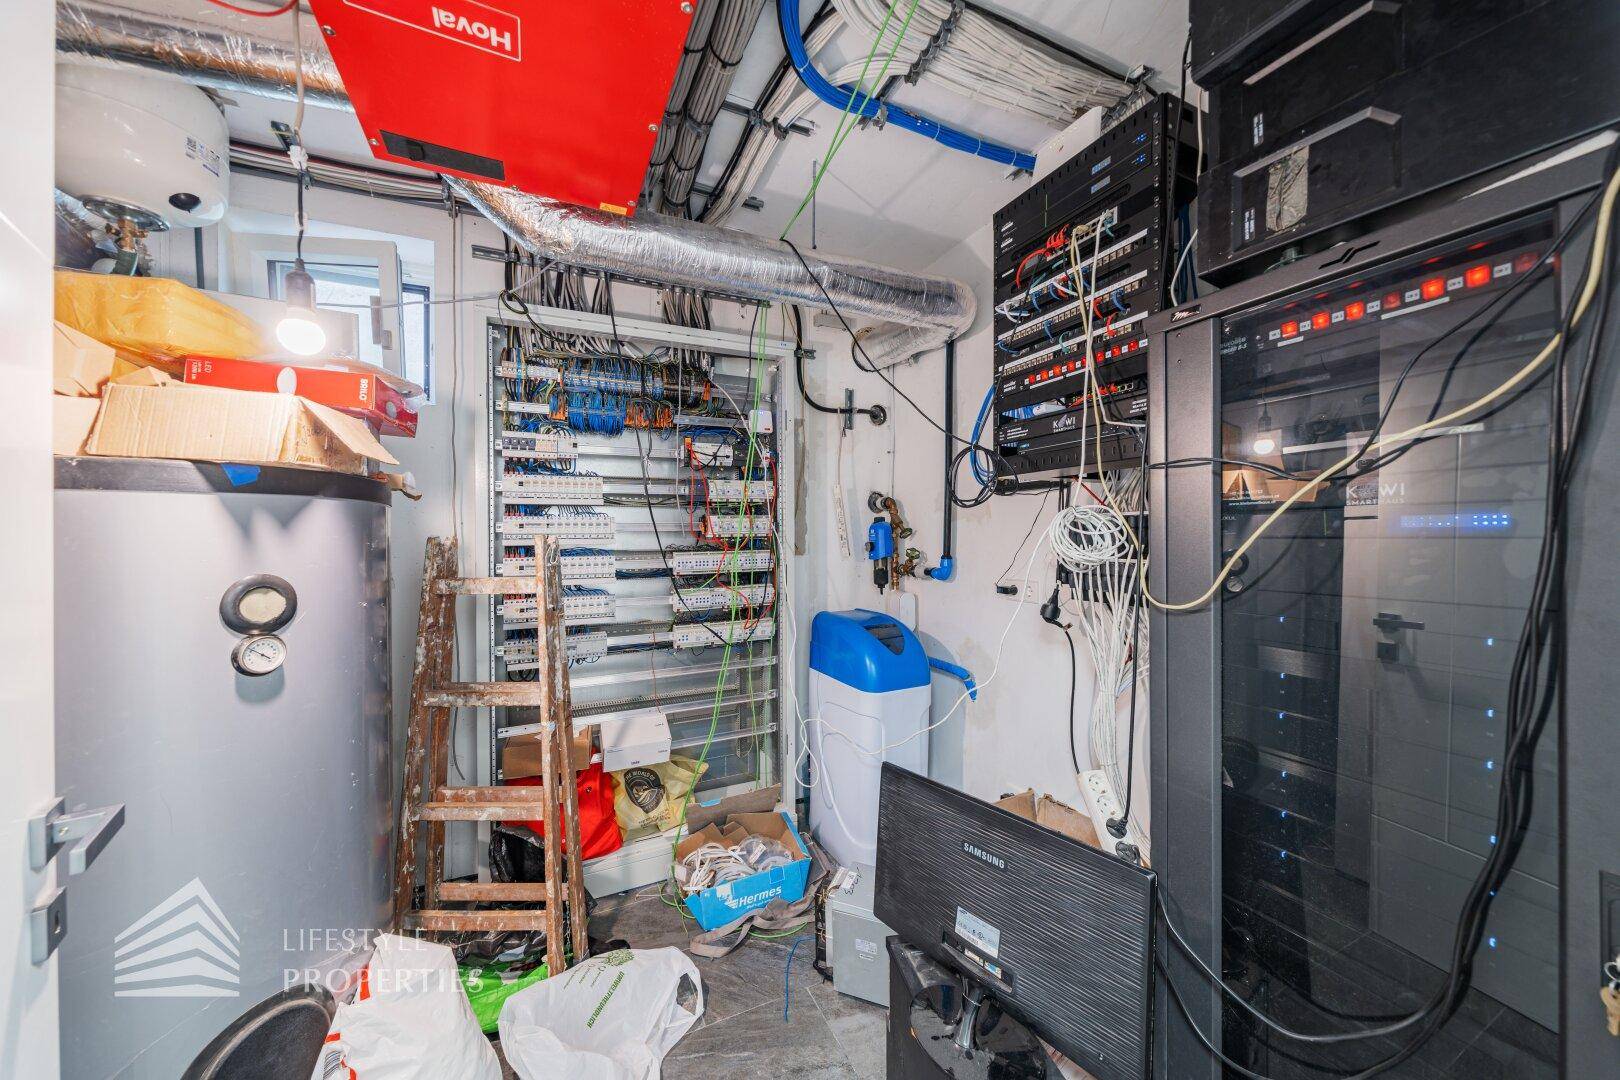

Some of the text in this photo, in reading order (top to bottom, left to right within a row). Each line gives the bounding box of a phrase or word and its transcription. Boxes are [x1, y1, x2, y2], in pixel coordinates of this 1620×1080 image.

[431, 6, 512, 52] Hoval
[963, 842, 1005, 869] SAMSUNG
[739, 885, 782, 908] Hermes
